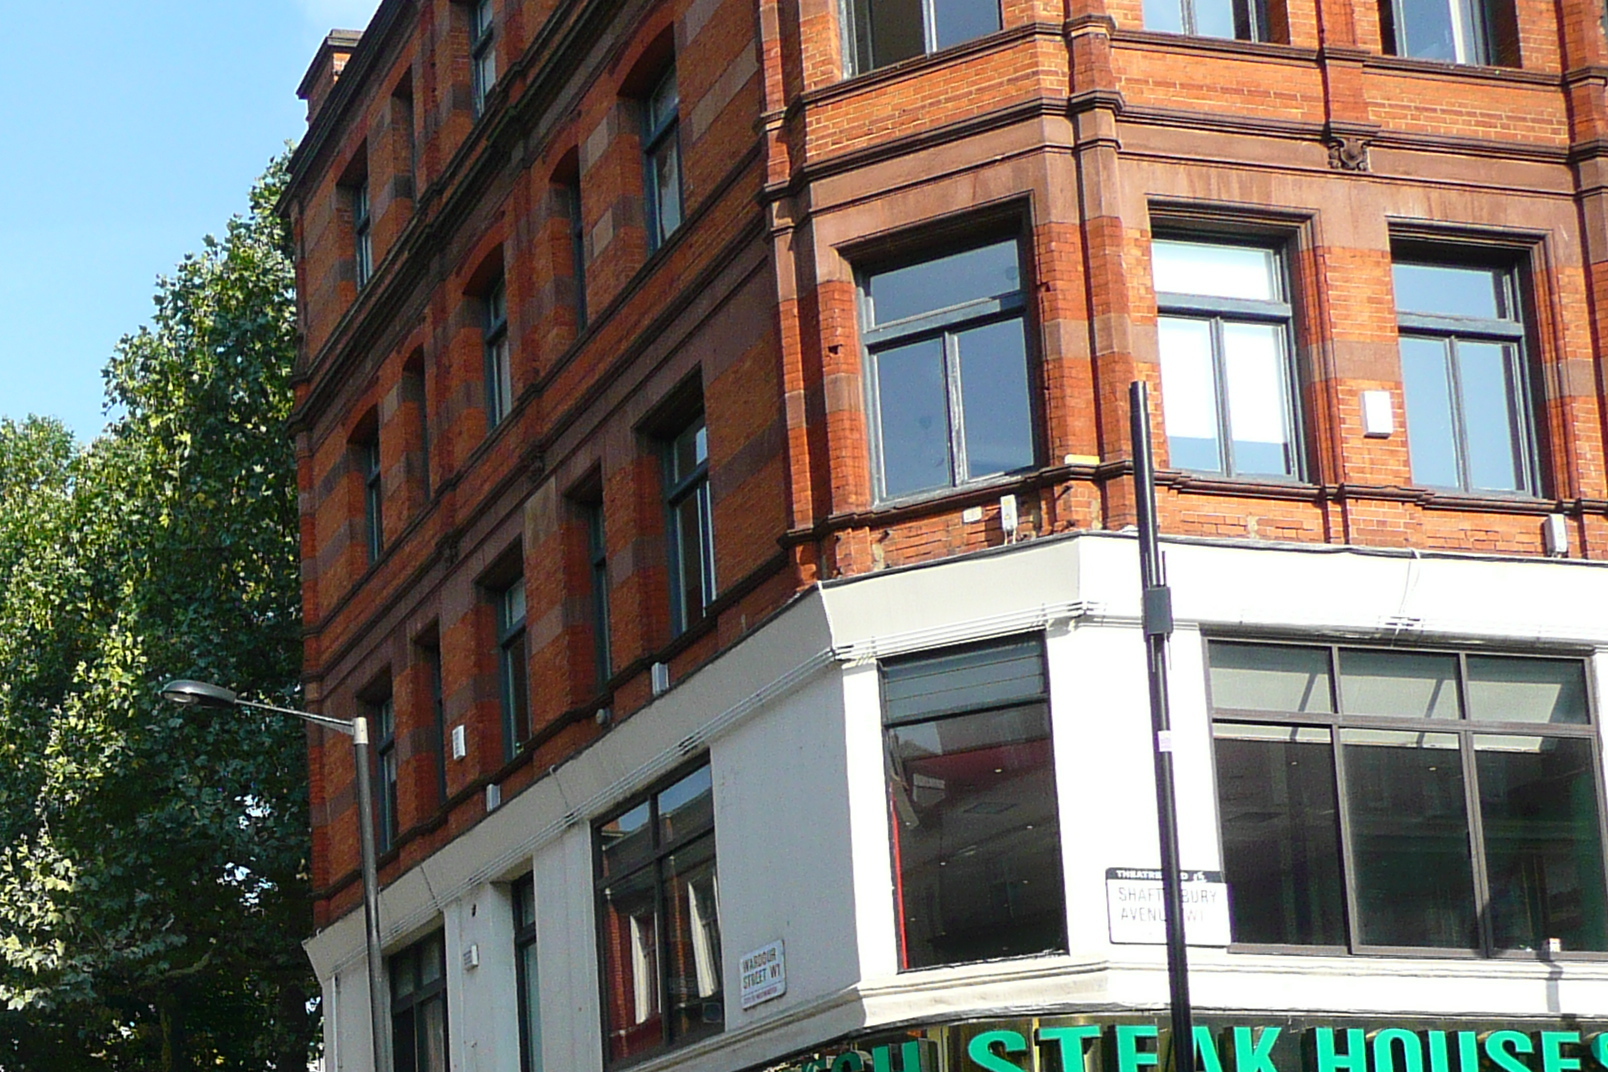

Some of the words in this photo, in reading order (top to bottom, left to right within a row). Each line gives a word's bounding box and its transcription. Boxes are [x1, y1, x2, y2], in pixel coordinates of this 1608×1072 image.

[1118, 887, 1217, 903] SHAFTBURY
[1121, 907, 1167, 922] AVENU
[769, 963, 781, 979] W1
